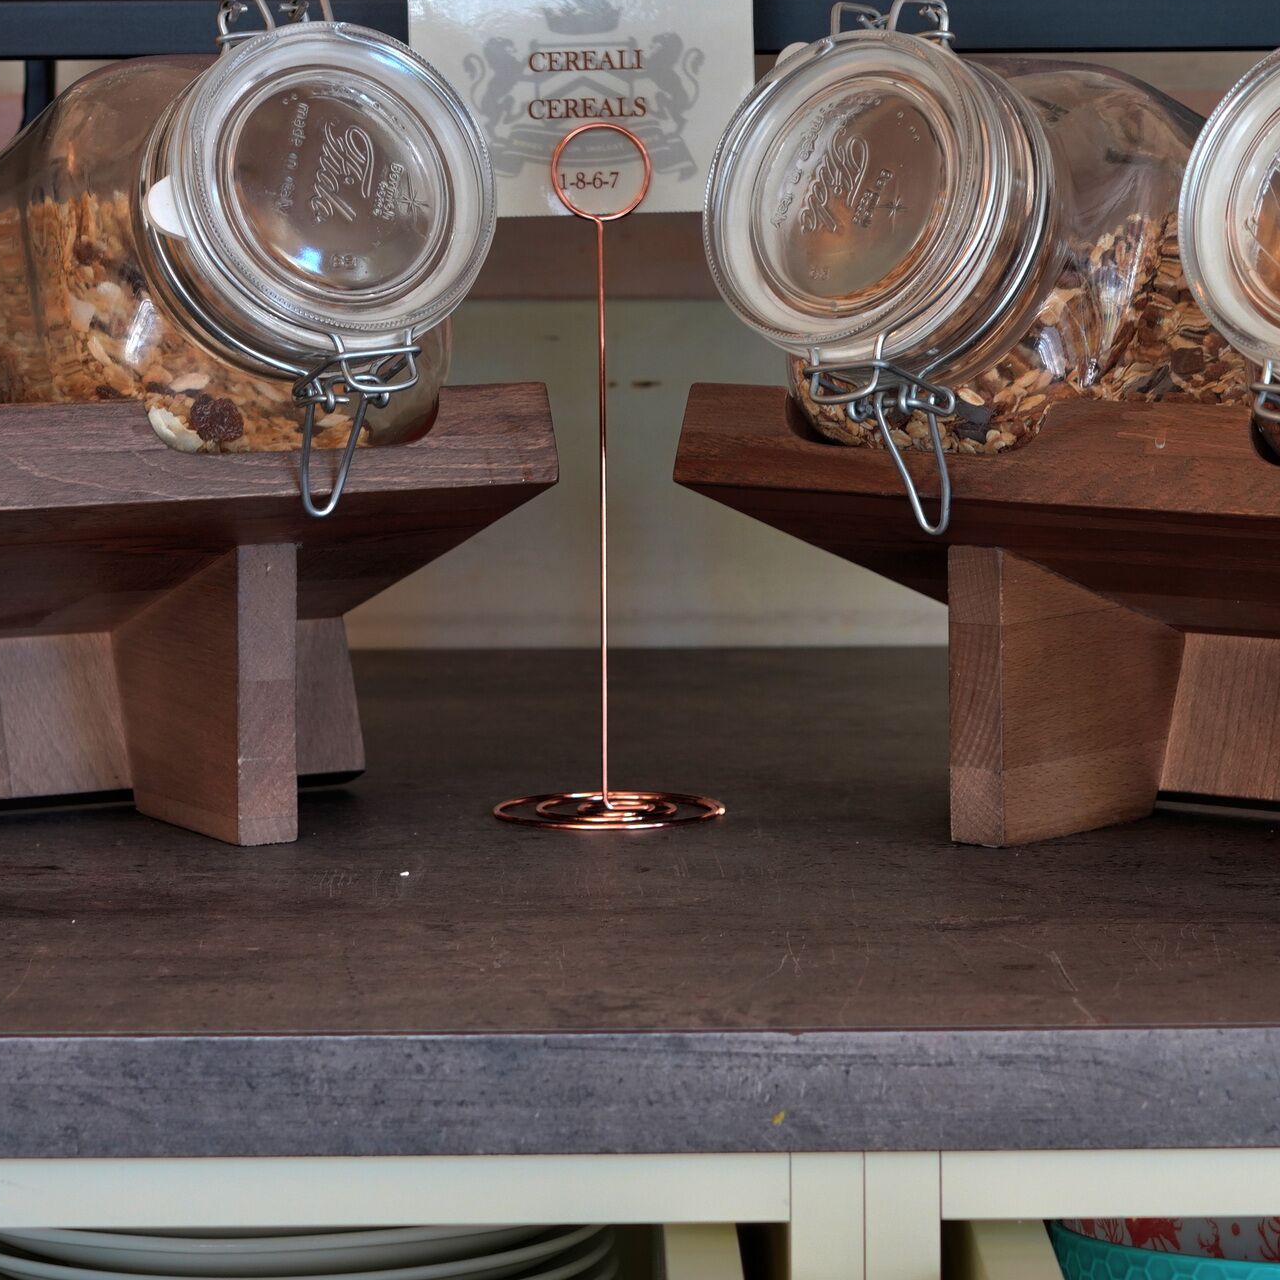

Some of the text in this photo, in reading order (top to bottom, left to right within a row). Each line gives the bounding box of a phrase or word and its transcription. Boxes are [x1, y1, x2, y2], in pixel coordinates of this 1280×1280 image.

[528, 48, 643, 73] CEREALI
[527, 96, 647, 120] CEREALS
[560, 172, 620, 190] 1-8-6-7
